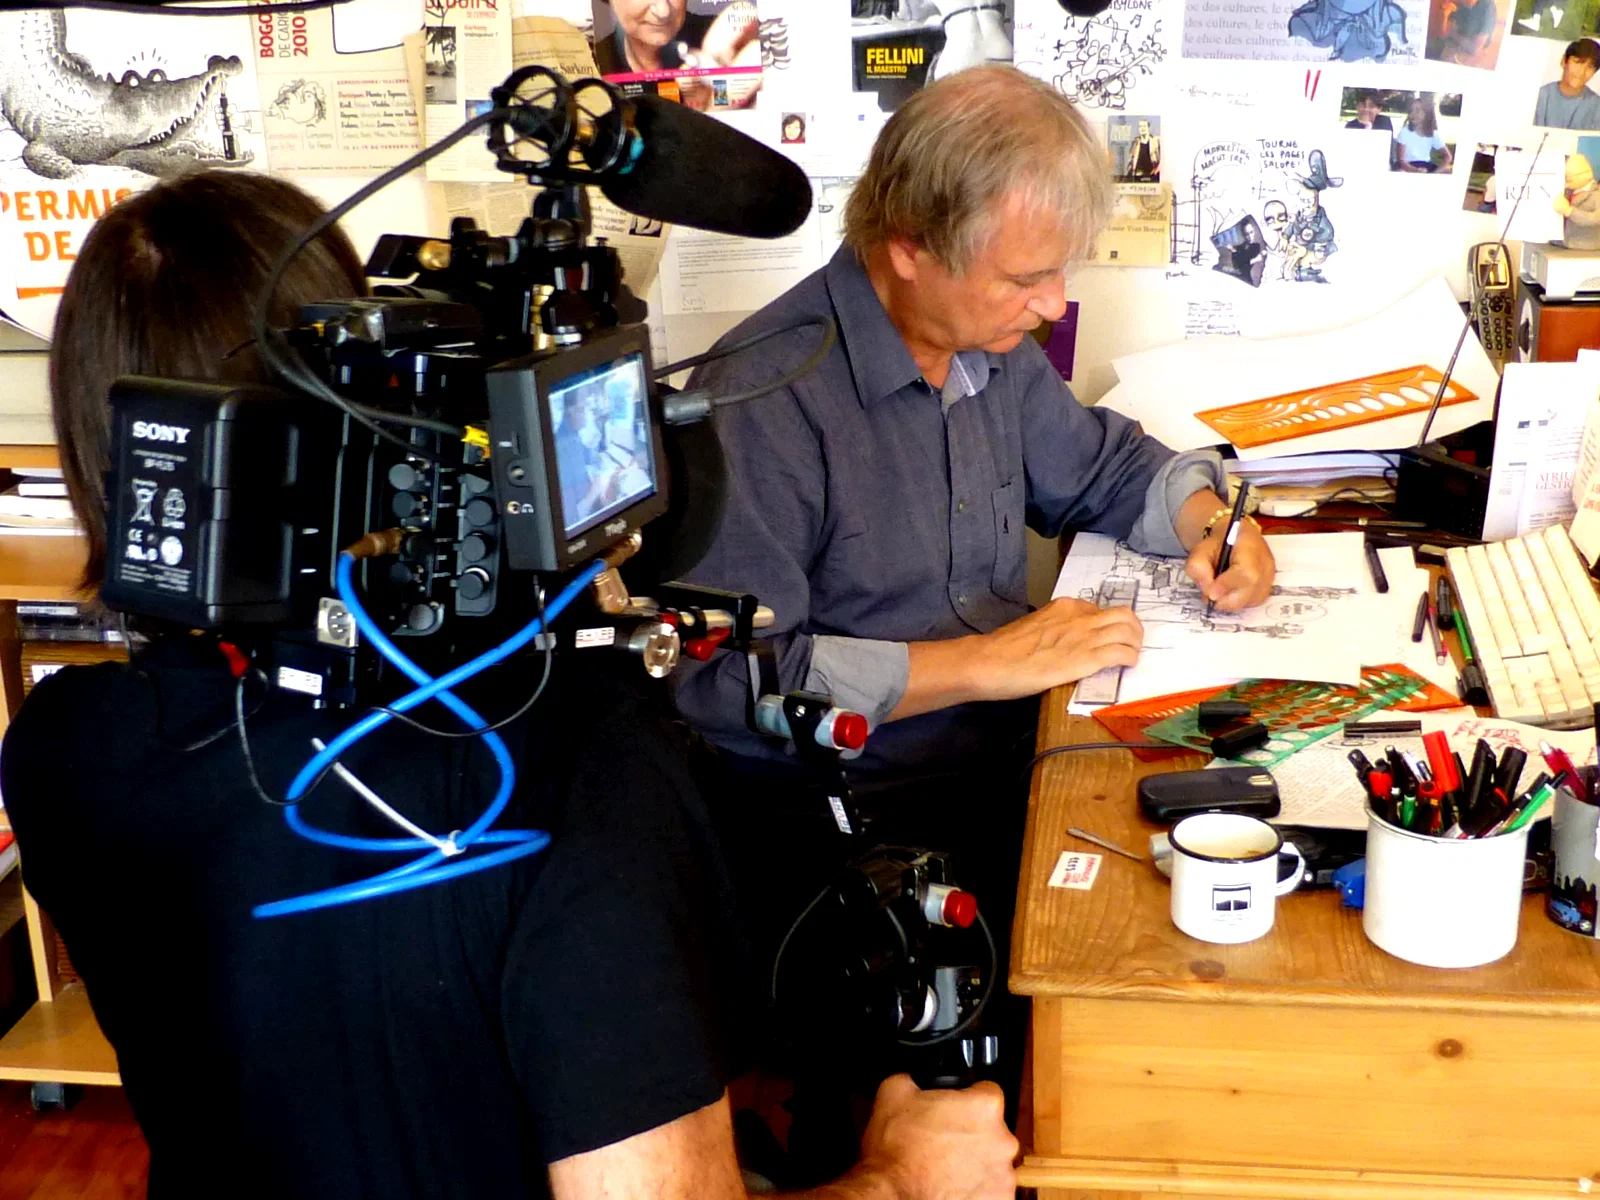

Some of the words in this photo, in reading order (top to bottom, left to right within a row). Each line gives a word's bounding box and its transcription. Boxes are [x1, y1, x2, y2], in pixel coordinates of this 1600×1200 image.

[1202, 1, 1220, 11] des
[1272, 4, 1282, 13] le
[1185, 17, 1203, 28] des
[1255, 20, 1265, 30] le
[292, 16, 308, 57] 2010
[1184, 33, 1194, 44] le
[1196, 33, 1221, 45] choc
[1224, 34, 1243, 45] des
[278, 44, 291, 58] DE
[866, 47, 924, 65] FELLINI
[1182, 49, 1201, 60] des
[1251, 51, 1261, 61] le
[1264, 51, 1289, 61] choc
[866, 65, 873, 74] IL
[873, 65, 908, 74] MAESTRO
[1203, 142, 1250, 161] MARKETING
[1256, 138, 1298, 150] TOURNE
[1280, 151, 1305, 160] PAGES
[23, 230, 77, 262] DE
[133, 421, 191, 443] SONY
